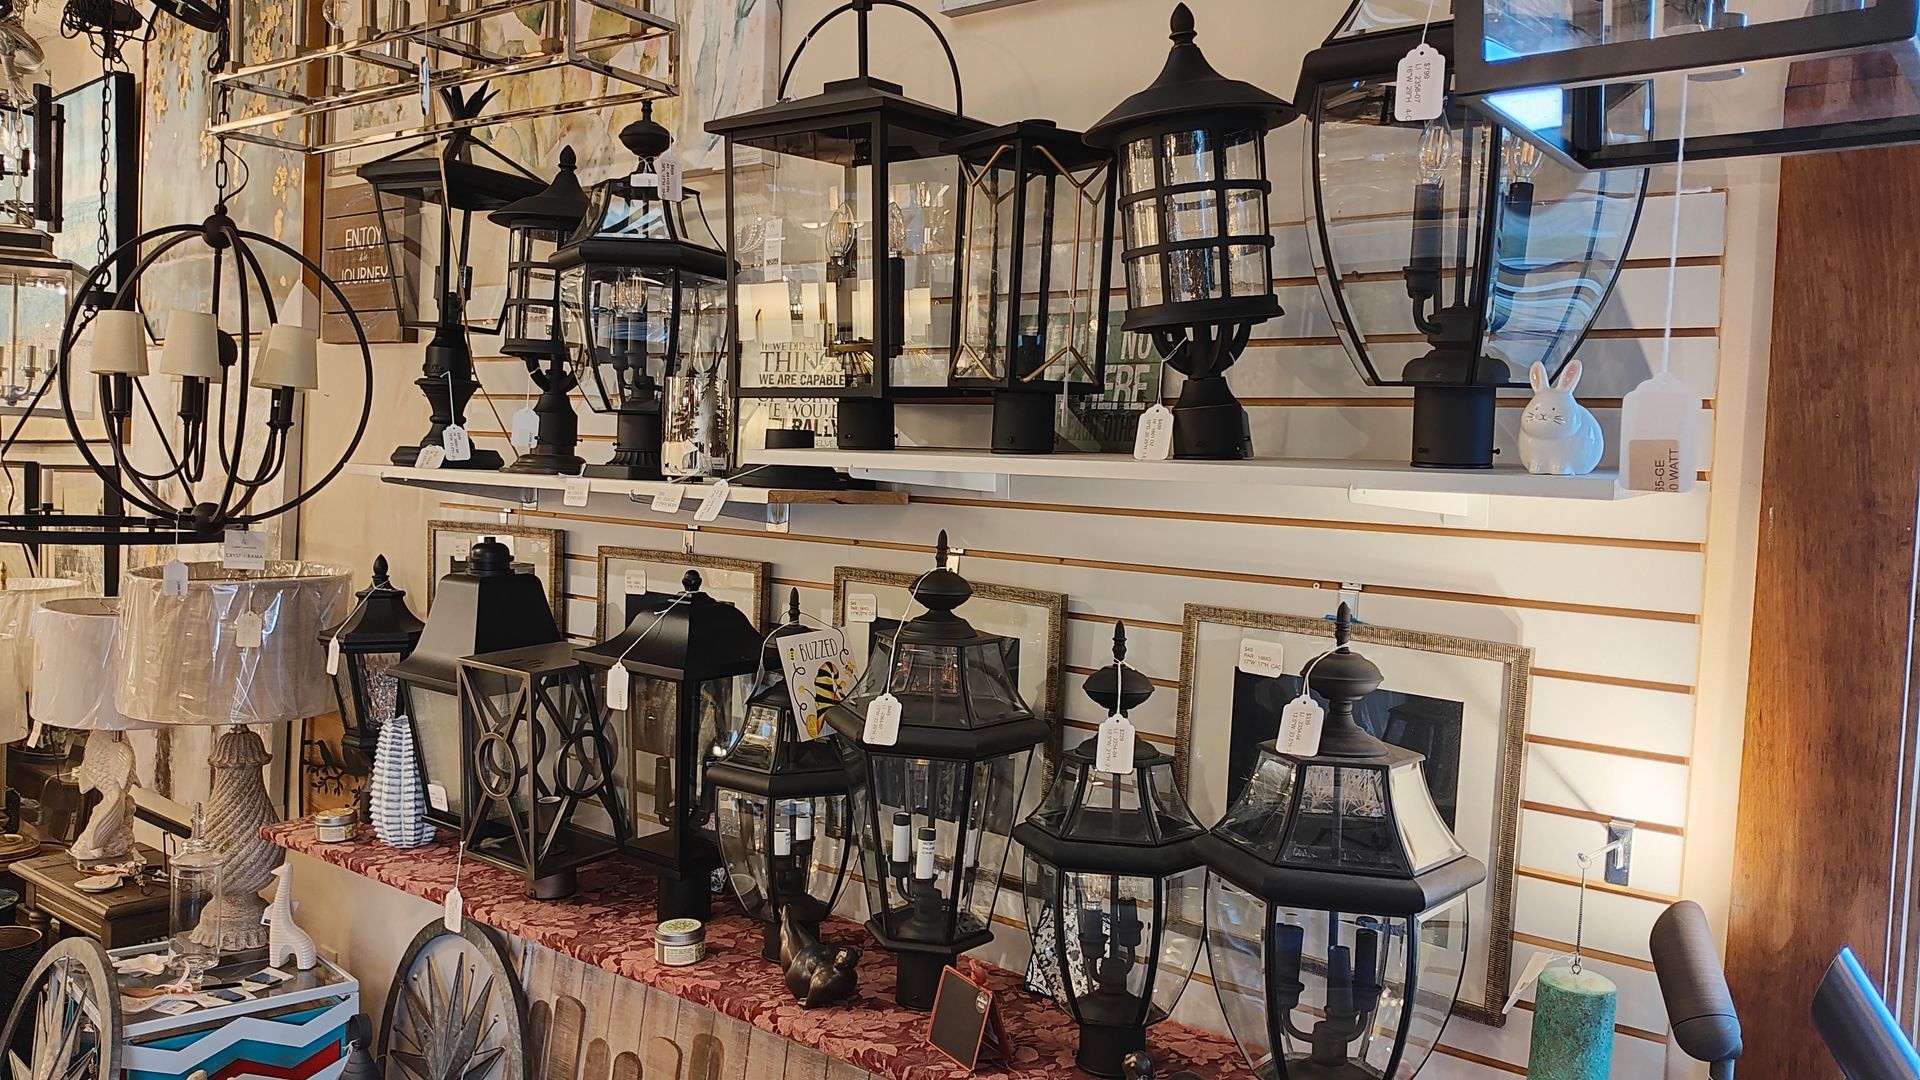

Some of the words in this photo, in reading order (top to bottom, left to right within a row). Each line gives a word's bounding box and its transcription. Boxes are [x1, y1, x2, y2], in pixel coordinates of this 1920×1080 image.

[1423, 62, 1431, 79] $799
[345, 226, 382, 252] ENJOY
[338, 265, 388, 285] JOURNEY
[773, 342, 786, 350] WE
[790, 342, 807, 350] DID
[808, 342, 824, 350] ALL
[759, 374, 774, 386] WE
[777, 374, 797, 386] ARE
[800, 374, 845, 386] CAPABLE
[1668, 448, 1679, 480] WATT
[799, 638, 838, 662] BUZZED
